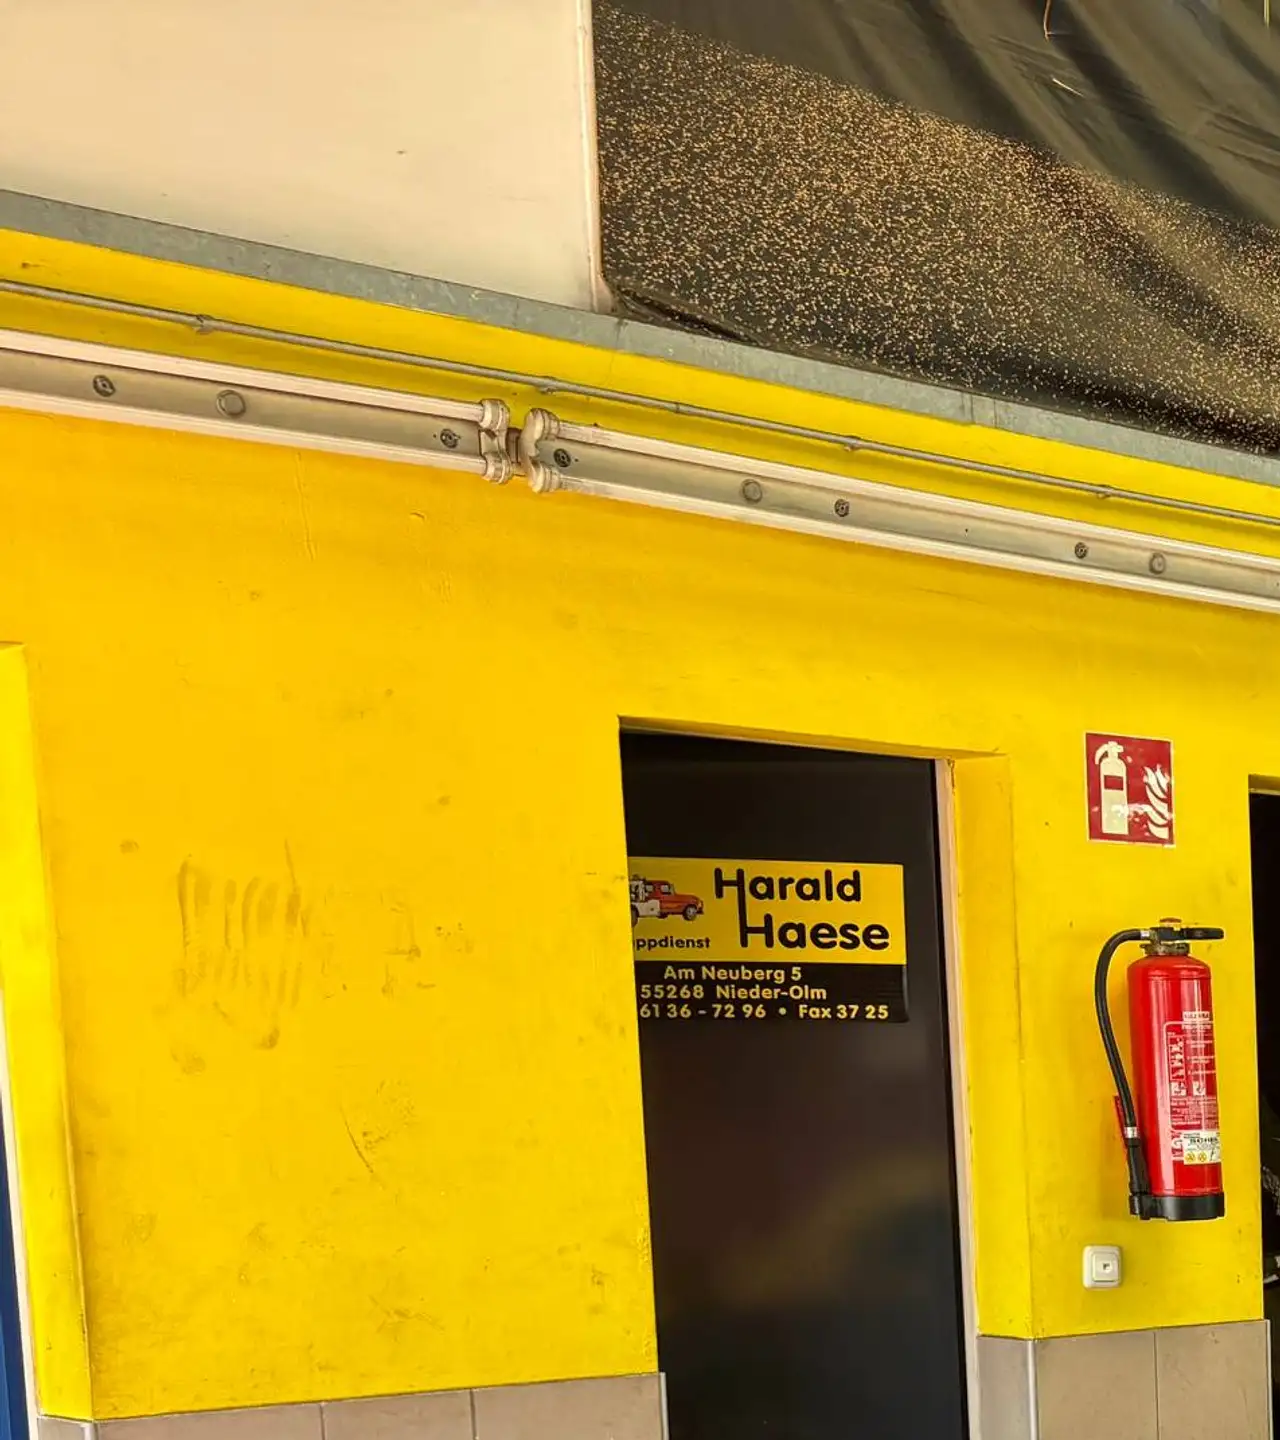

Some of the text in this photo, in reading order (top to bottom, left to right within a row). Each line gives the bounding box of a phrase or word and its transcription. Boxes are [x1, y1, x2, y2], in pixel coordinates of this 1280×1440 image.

[713, 867, 862, 901] Harald
[738, 912, 890, 951] Haese
[664, 965, 802, 984] Am Neuberg 5
[640, 984, 827, 1000] 55268 Nieder-Olm
[798, 1004, 832, 1019] Fax
